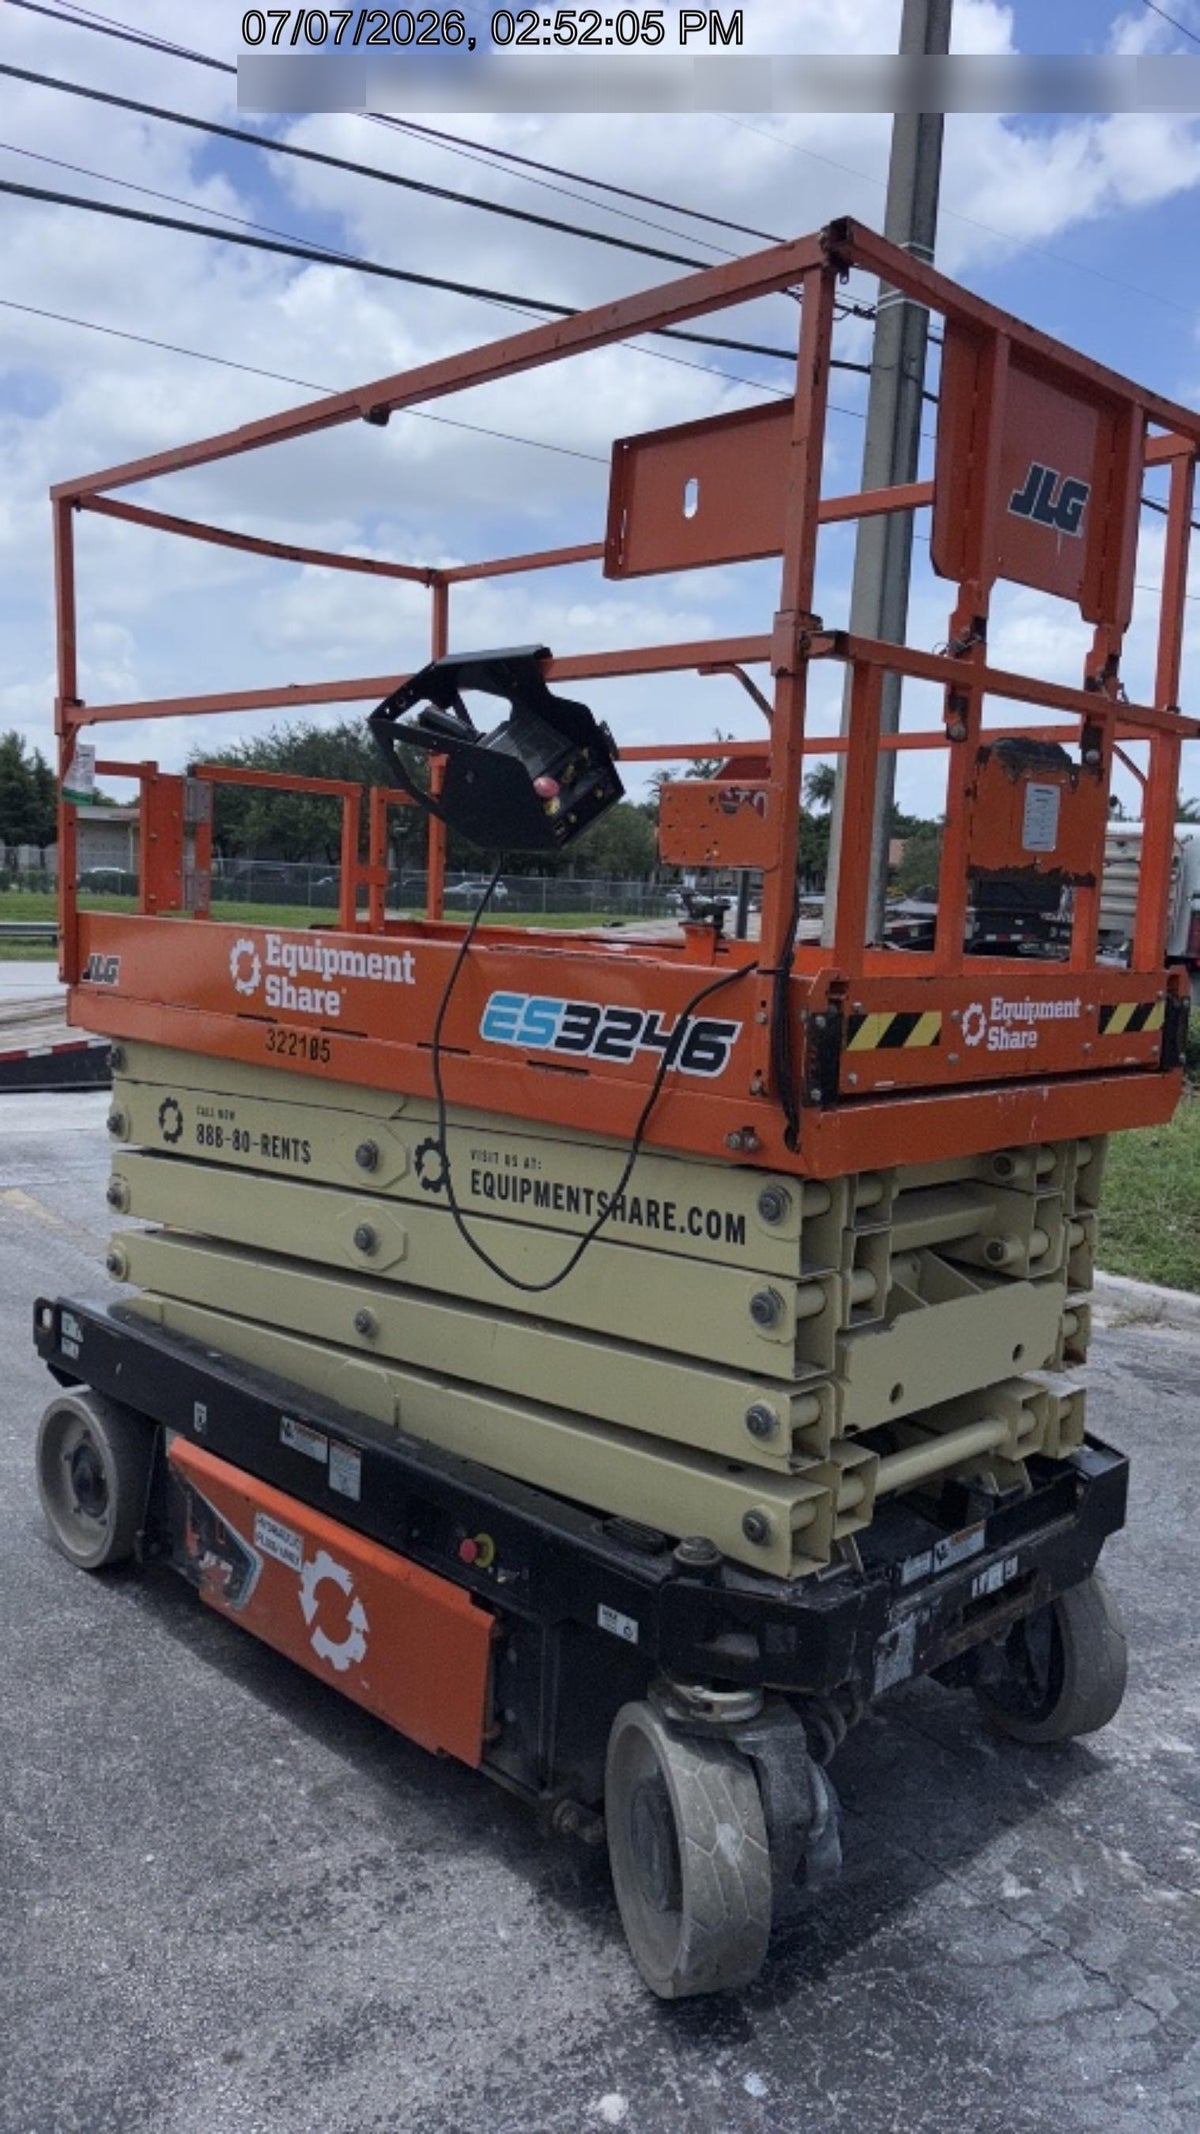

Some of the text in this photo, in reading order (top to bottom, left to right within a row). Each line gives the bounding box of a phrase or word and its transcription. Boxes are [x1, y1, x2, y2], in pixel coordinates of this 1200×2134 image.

[1008, 461, 1091, 537] JLG
[265, 934, 416, 985] Equipment
[265, 974, 341, 1017] Share
[989, 995, 1082, 1026] Equipment
[480, 991, 743, 1077] ES3246
[987, 1026, 1038, 1052] Share
[196, 1123, 311, 1166] 888-80-RENTS
[470, 1168, 747, 1246] EQUIPMENTSHARE.COM
